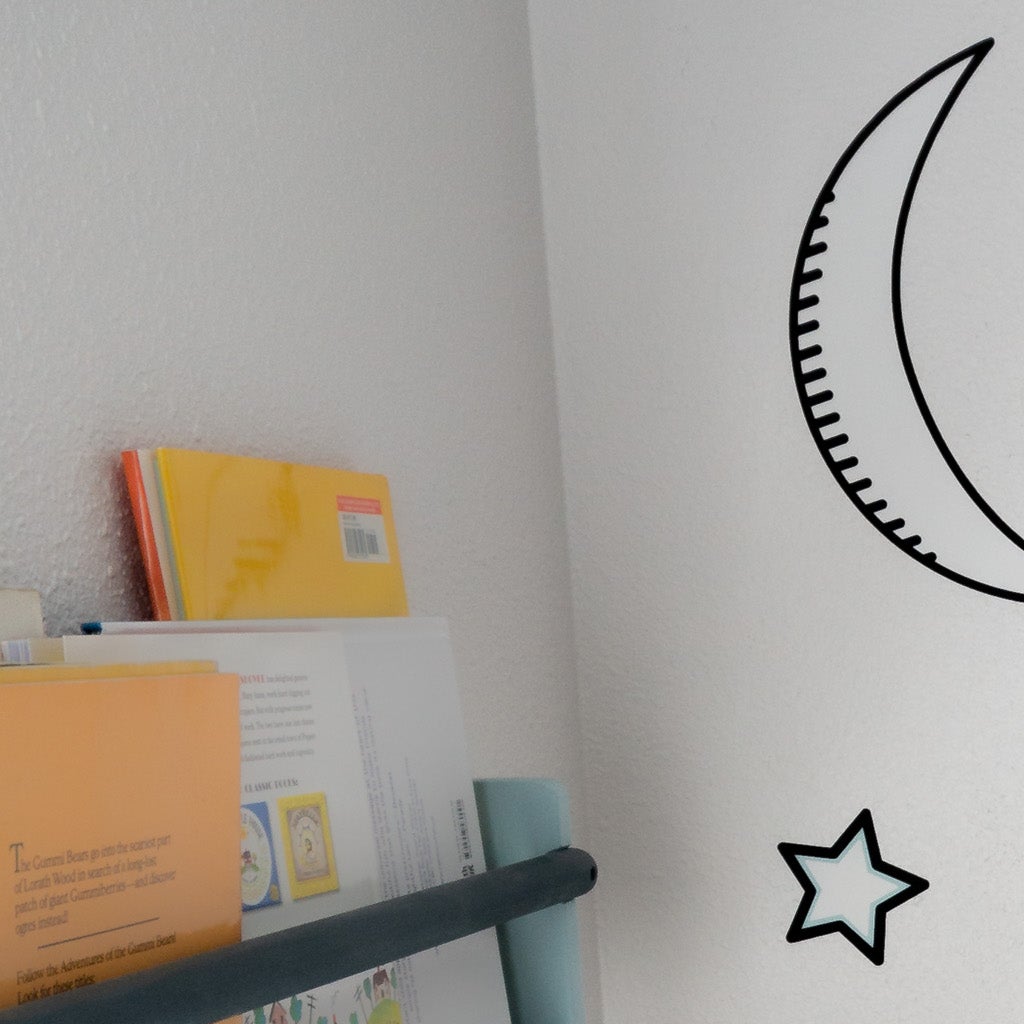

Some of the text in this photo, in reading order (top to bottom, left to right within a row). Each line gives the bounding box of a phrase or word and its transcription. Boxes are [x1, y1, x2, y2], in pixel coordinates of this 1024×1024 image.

[9, 834, 171, 873] The Gummi Bears go into the scariest part
[14, 877, 24, 894] of
[52, 871, 76, 887] Wood
[77, 869, 86, 882] in
[87, 864, 112, 878] search
[113, 860, 122, 874] of
[15, 897, 37, 918] patch
[39, 894, 49, 910] of
[49, 892, 69, 910] giant
[16, 968, 44, 985] Follow
[46, 963, 58, 978] the
[61, 951, 104, 972] Adventures
[105, 946, 115, 962] of
[115, 944, 127, 959] the
[127, 938, 156, 955] Gummi
[17, 988, 38, 1006] Look
[39, 984, 52, 999] for
